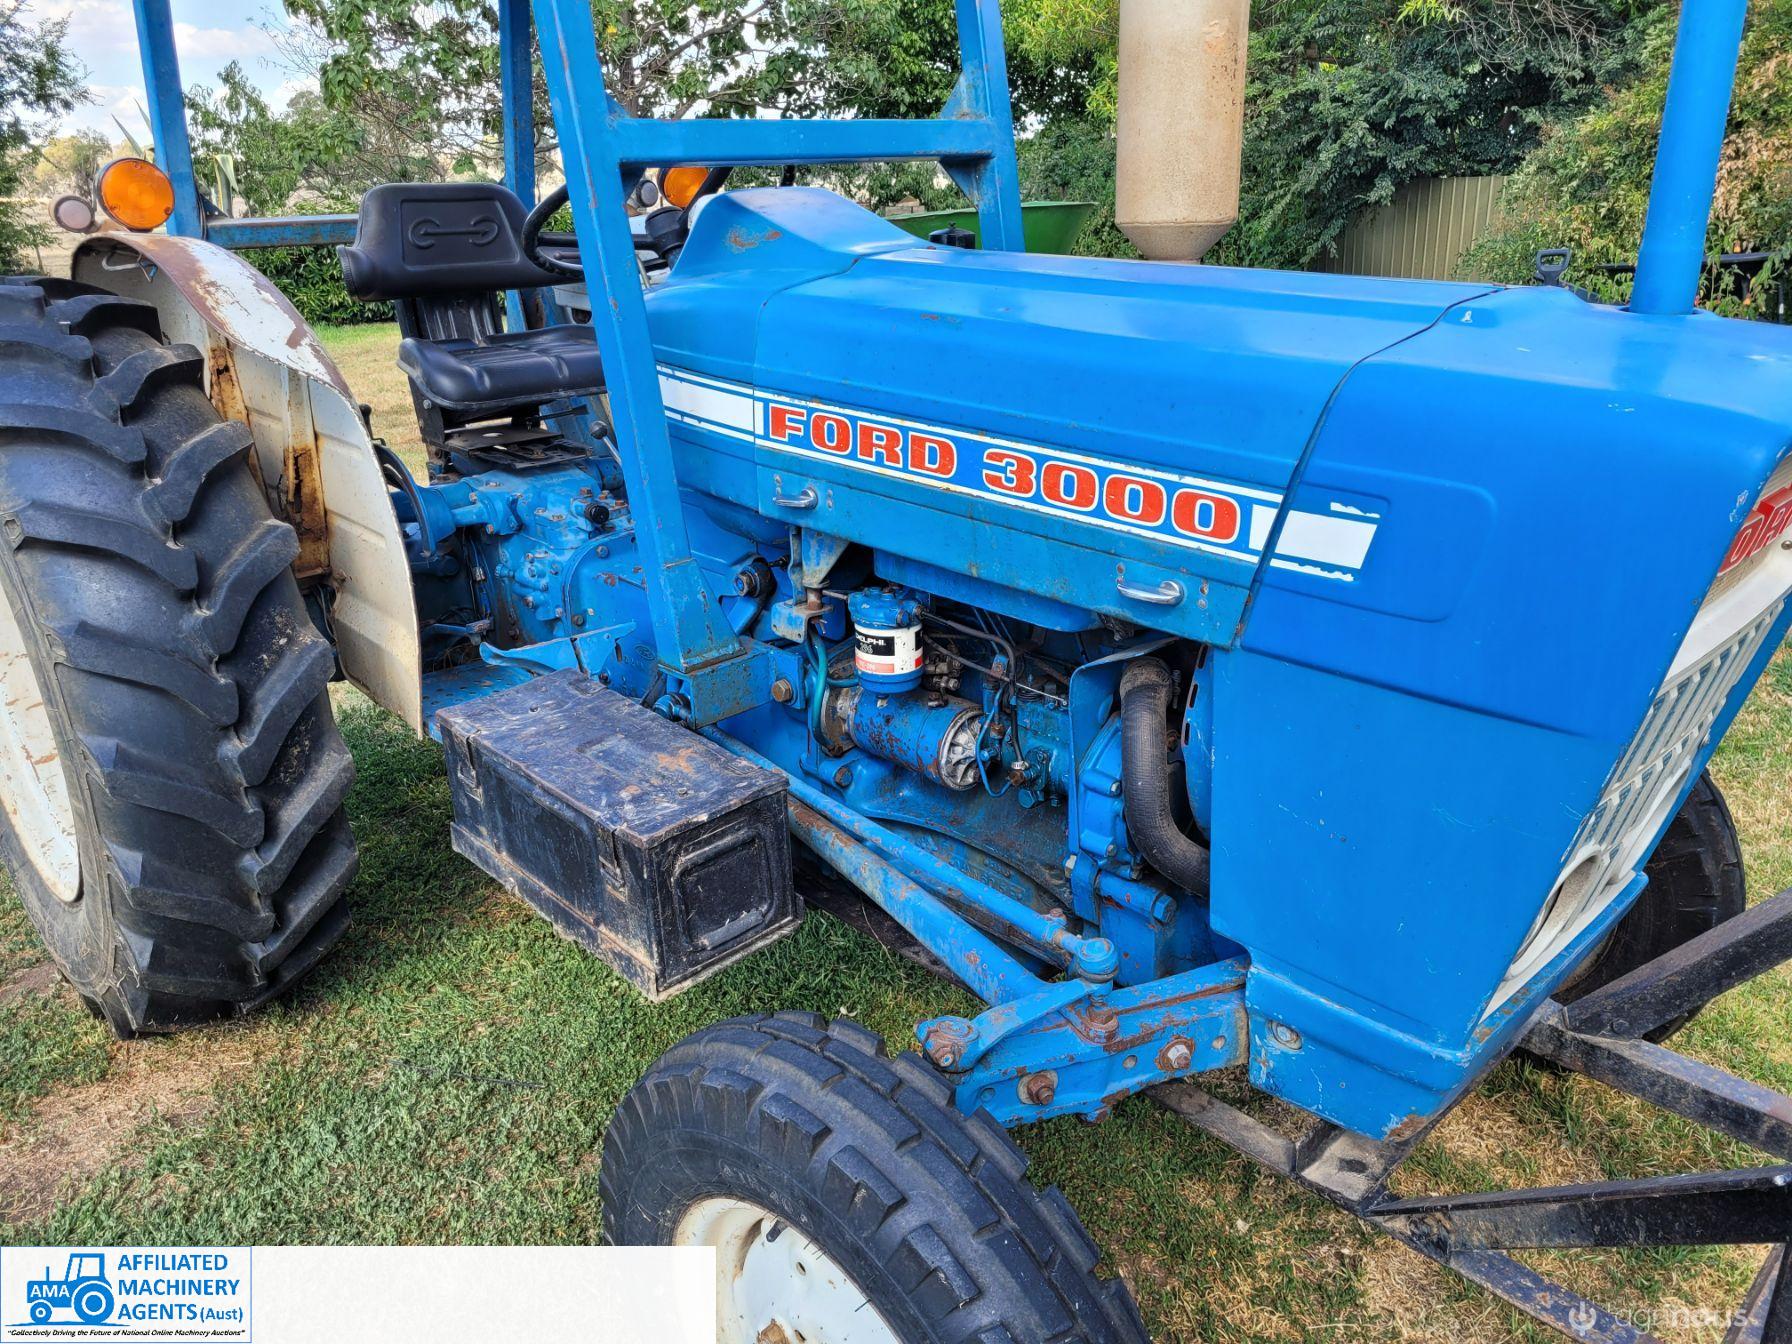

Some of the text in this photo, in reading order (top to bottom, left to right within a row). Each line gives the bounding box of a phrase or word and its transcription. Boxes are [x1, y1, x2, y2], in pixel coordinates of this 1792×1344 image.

[768, 405, 1242, 543] FORD 3000
[855, 632, 886, 646] DELPHI
